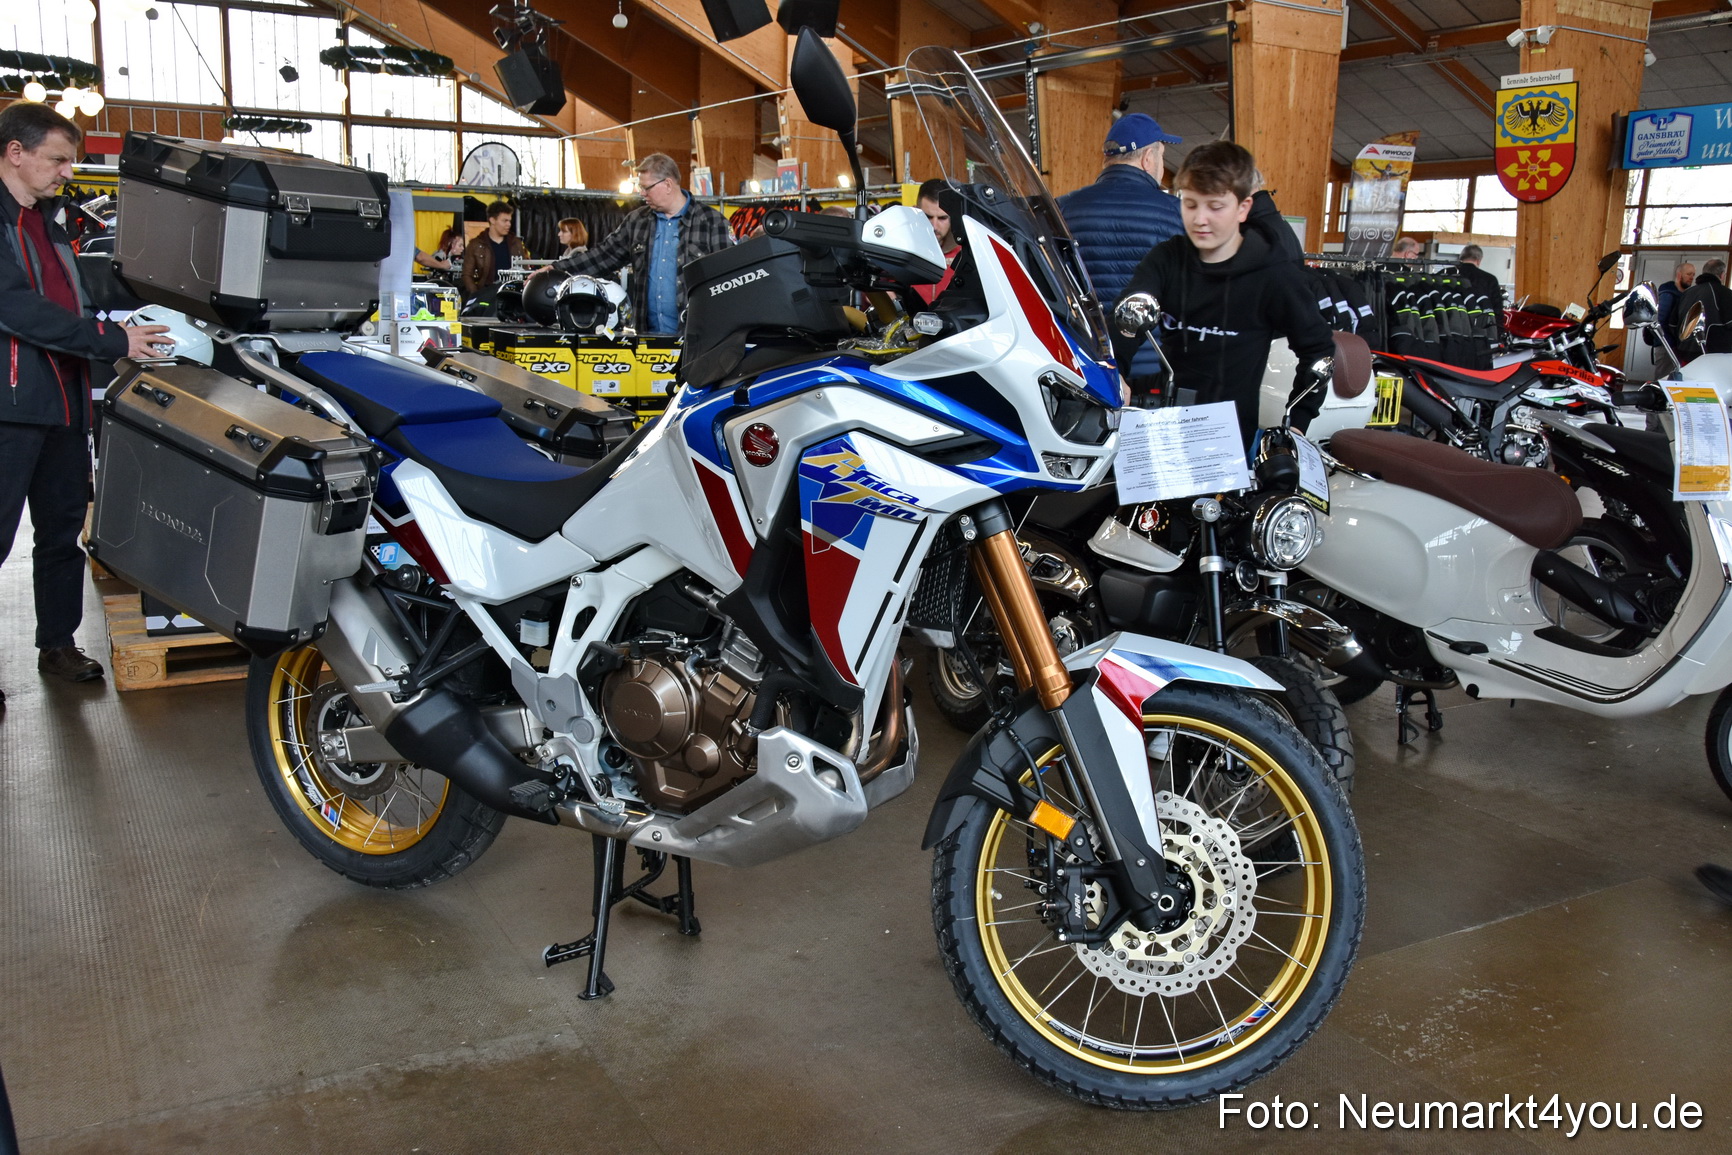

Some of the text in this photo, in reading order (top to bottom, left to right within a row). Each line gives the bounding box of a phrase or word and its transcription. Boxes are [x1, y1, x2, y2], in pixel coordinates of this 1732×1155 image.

[1506, 77, 1528, 85] Gemeinde
[709, 268, 770, 297] HONDA
[1557, 364, 1596, 384] aprilia
[744, 449, 773, 460] HONDA
[1582, 452, 1631, 477] VISION
[802, 446, 924, 508] Africa
[818, 481, 926, 524] Twin
[141, 501, 206, 546] HONDA
